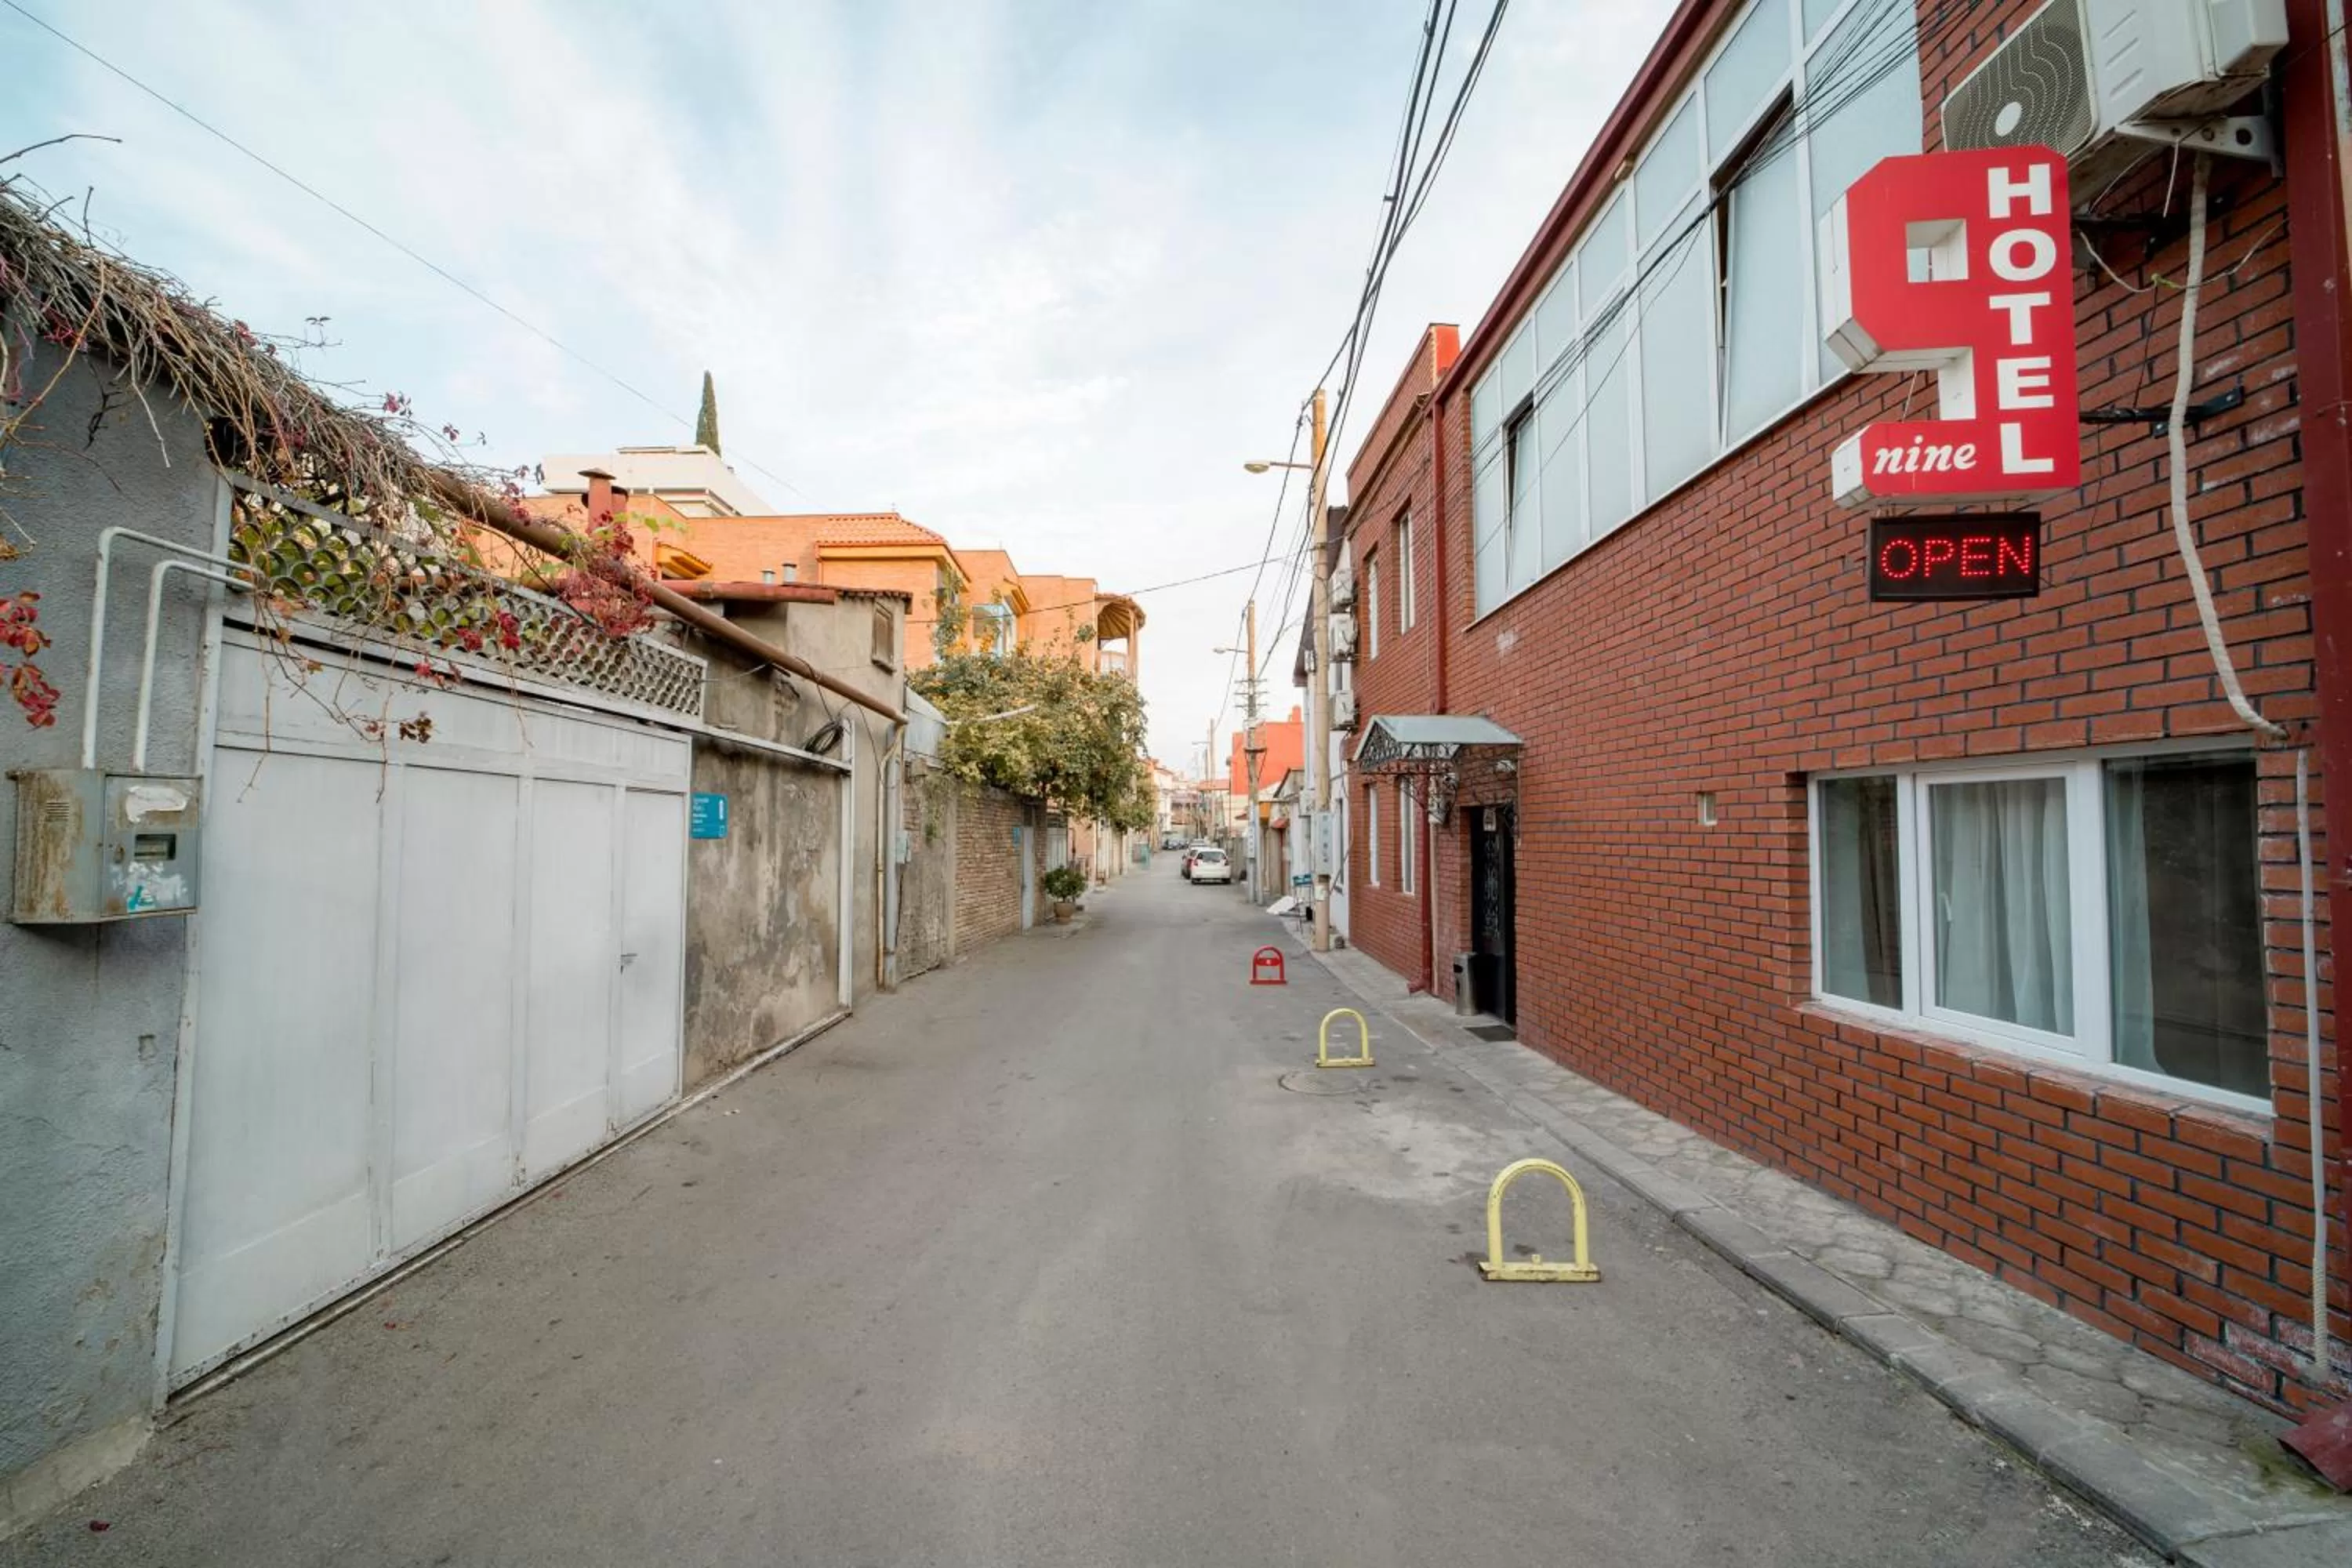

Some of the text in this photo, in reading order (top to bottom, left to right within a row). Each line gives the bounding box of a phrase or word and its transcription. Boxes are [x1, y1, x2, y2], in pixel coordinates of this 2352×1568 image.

[1987, 163, 2056, 474] HOTEL
[1872, 434, 1977, 475] nine
[1881, 535, 2031, 579] OPEN
